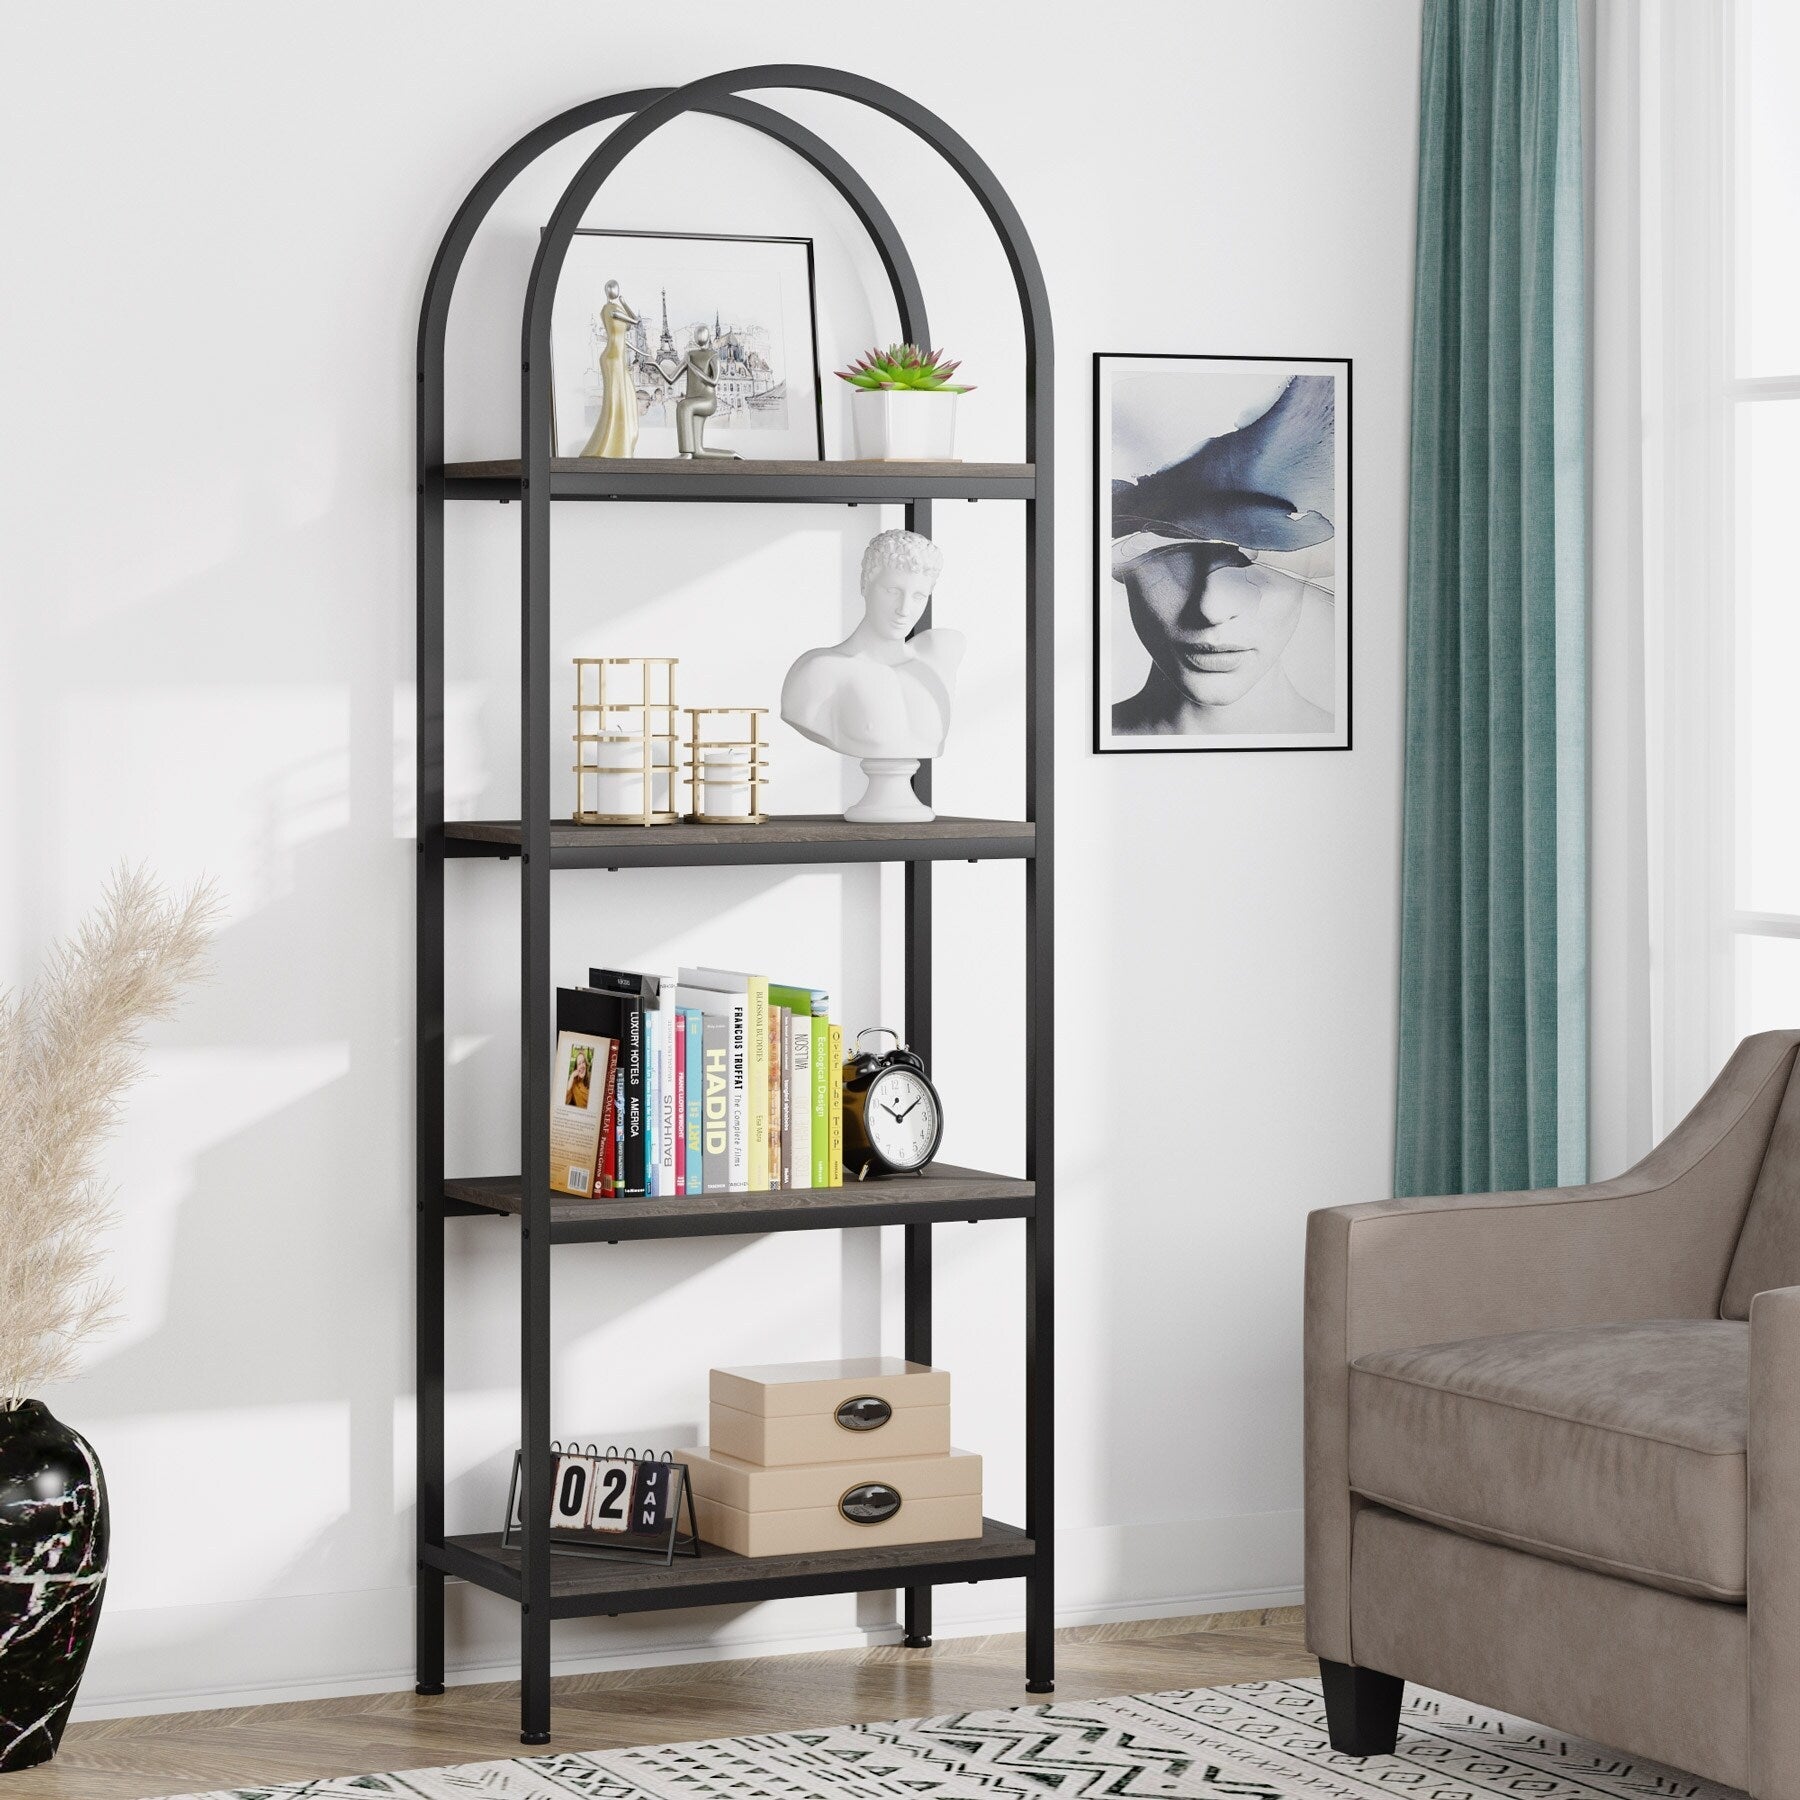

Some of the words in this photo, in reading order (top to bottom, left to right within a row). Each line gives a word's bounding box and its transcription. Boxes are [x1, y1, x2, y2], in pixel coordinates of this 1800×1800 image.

[630, 1012, 640, 1047] LUXURY
[734, 1007, 743, 1049] FRANCOIS
[630, 1050, 640, 1085] HOTELS
[815, 1036, 826, 1082] Ecological
[734, 1053, 743, 1090] TRUFFAT
[880, 1085, 888, 1095] 11
[891, 1079, 899, 1090] 12
[906, 1083, 911, 1094] 1
[604, 1096, 613, 1113] OAK
[706, 1049, 727, 1155] HADID
[734, 1094, 742, 1107] The
[815, 1086, 826, 1117] Design
[602, 1113, 611, 1133] LEAF
[630, 1097, 640, 1138] AMERICA
[922, 1112, 927, 1122] 3
[664, 1095, 673, 1167] BAUHAUS
[733, 1110, 742, 1145] Complete
[920, 1129, 925, 1139] 4
[886, 1144, 891, 1154] 7
[899, 1149, 904, 1159] 6
[912, 1141, 918, 1152] 5
[734, 1148, 742, 1167] Films
[642, 1472, 657, 1525] JAN
